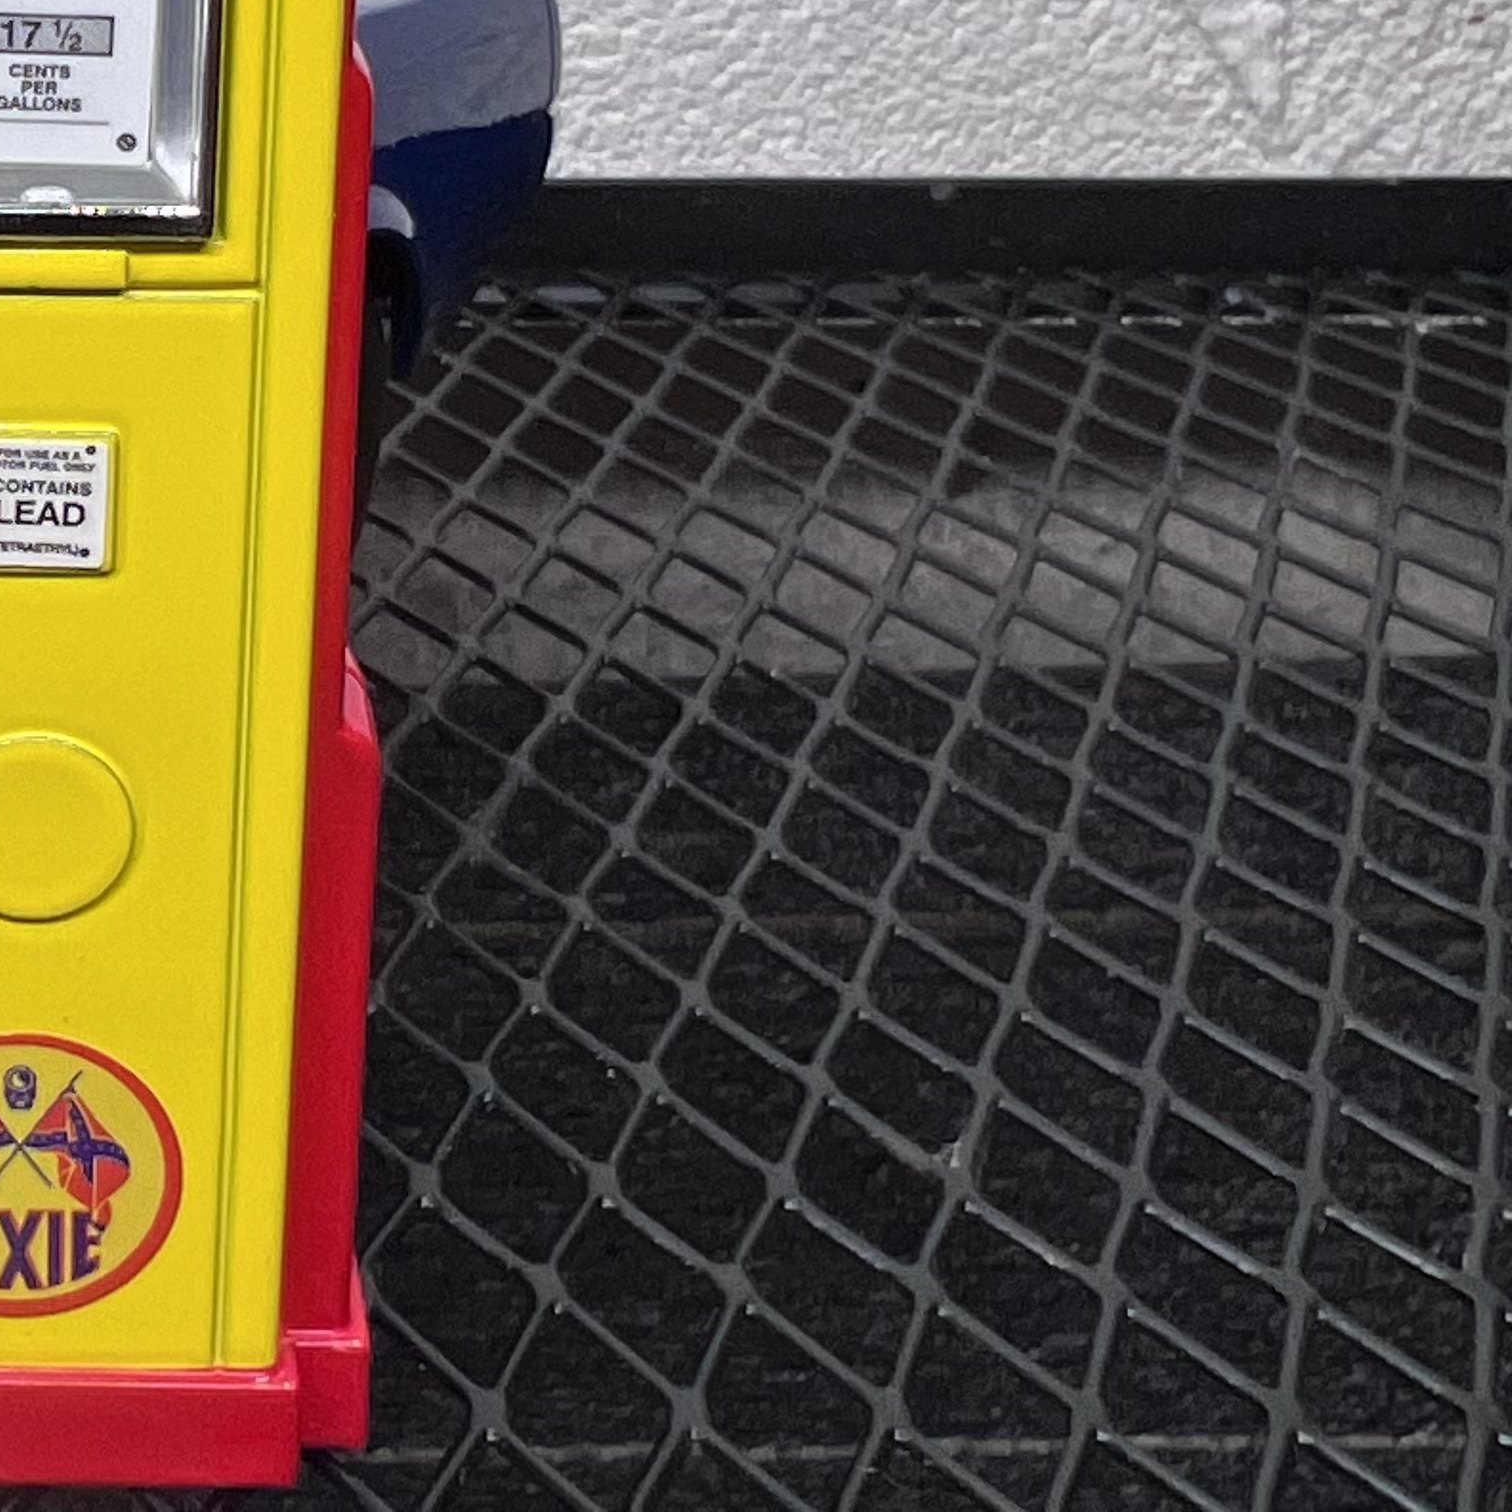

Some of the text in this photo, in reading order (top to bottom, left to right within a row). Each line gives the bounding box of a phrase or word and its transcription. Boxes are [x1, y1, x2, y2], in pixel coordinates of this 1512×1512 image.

[8, 63, 71, 79] CENTS
[20, 80, 58, 95] PER
[29, 461, 61, 472] FUEL
[63, 462, 96, 473] ONLY
